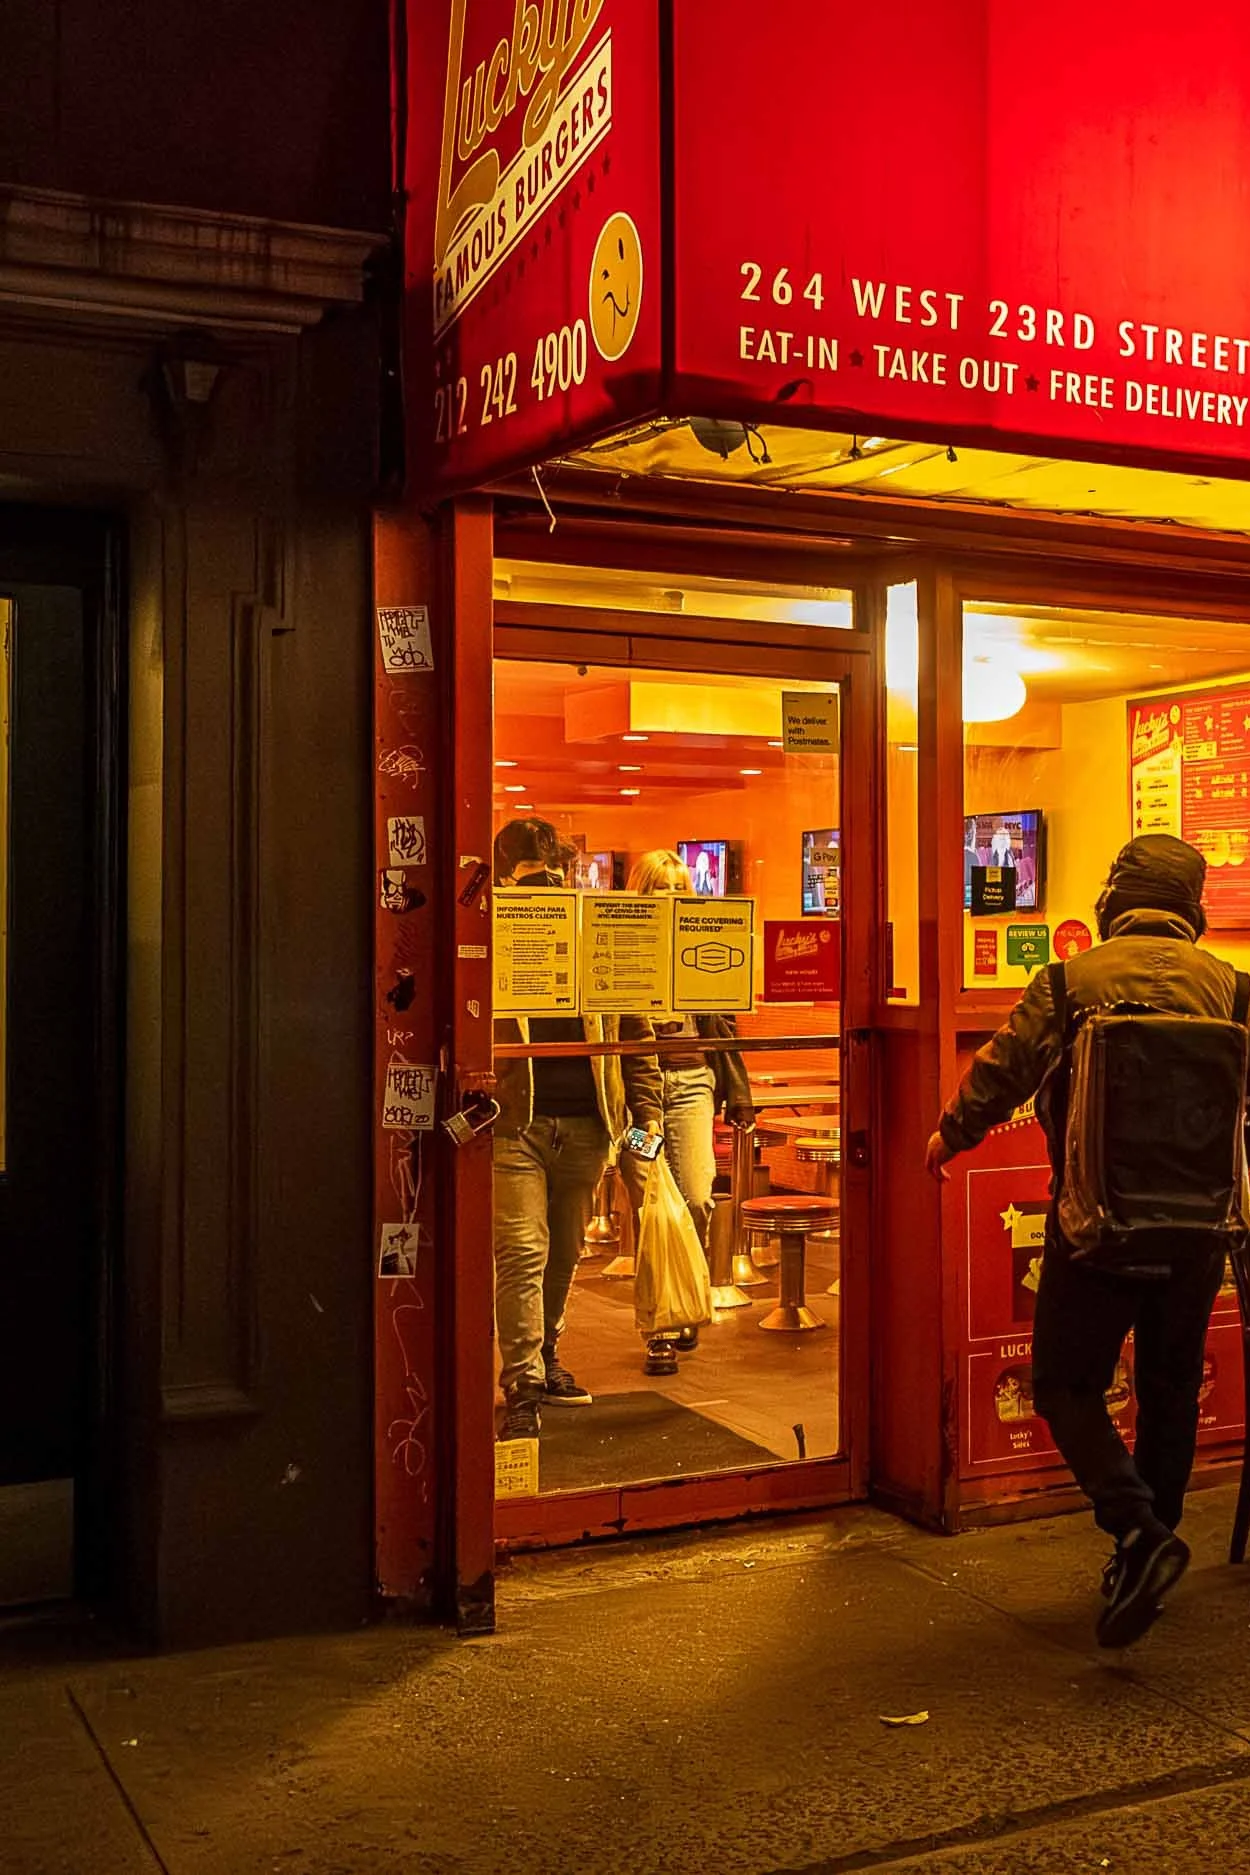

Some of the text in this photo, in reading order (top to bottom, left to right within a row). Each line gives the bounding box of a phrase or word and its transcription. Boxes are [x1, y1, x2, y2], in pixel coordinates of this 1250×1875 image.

[434, 0, 604, 268] Lucky
[436, 64, 609, 320] FAMOUS BURGERS
[740, 261, 1250, 375] 264 WEST 23RD STREET
[434, 318, 588, 443] 212 242 4900
[740, 326, 1249, 427] EAT-IN TAKE OUT FREE DELIVERY
[788, 715, 800, 725] We
[679, 916, 744, 926] FACE COVERING
